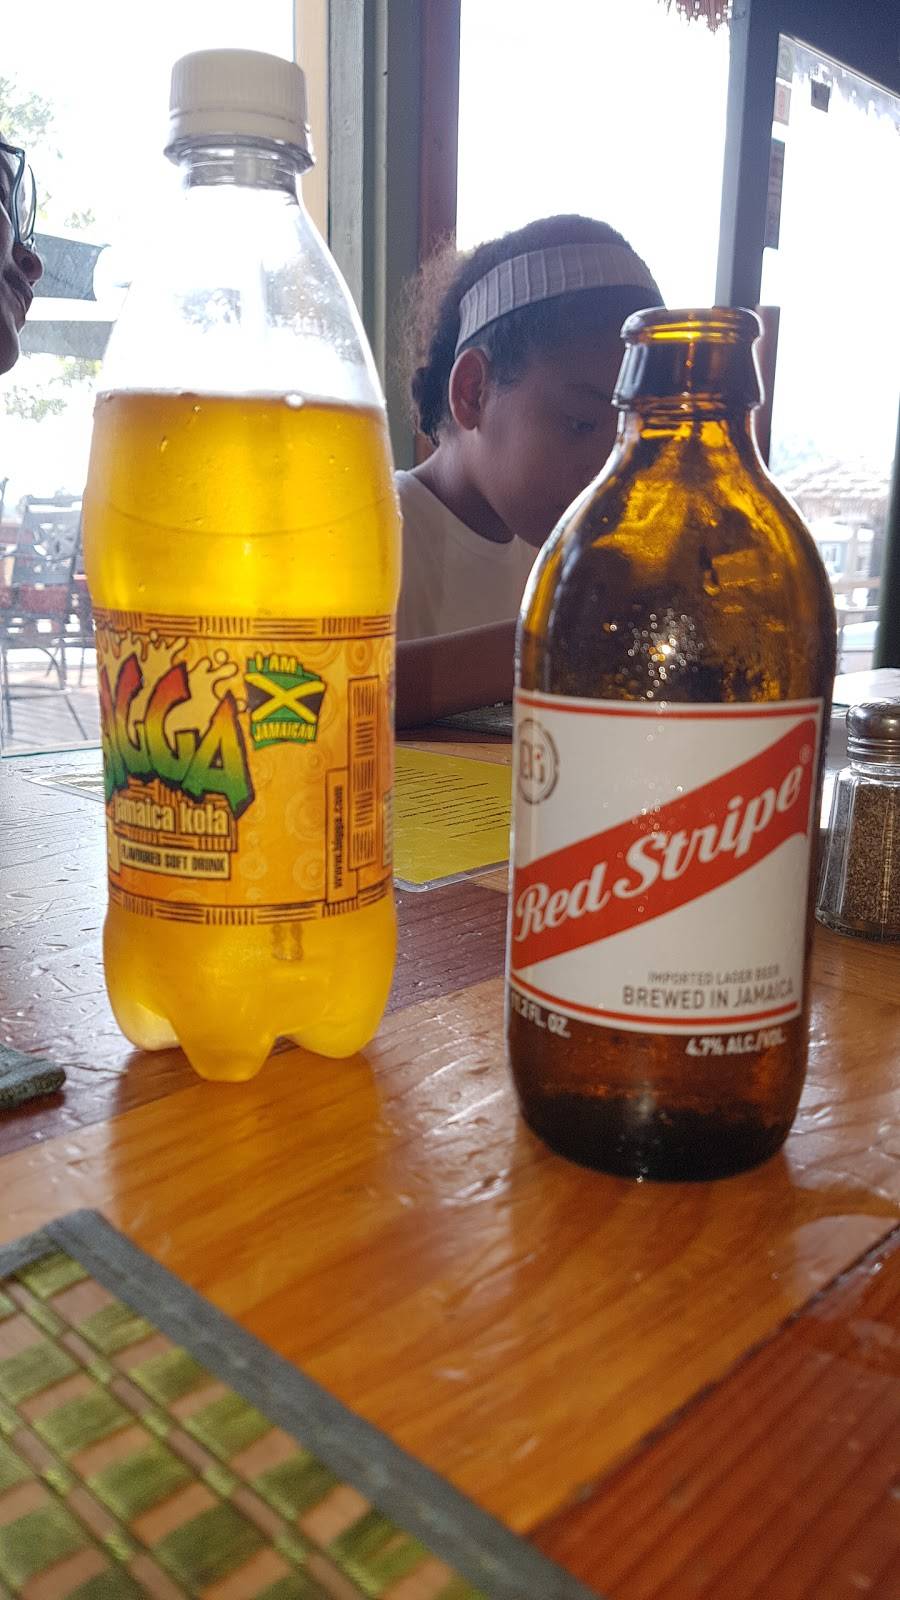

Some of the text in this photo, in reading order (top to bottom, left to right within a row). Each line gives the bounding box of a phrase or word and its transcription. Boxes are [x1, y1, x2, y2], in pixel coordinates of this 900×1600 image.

[255, 652, 297, 673] I AM
[255, 721, 316, 742] JAMAICAN
[180, 800, 229, 836] kola
[165, 853, 188, 871] SOFT
[191, 856, 226, 873] DRINK
[514, 861, 611, 942] Red
[612, 764, 804, 899] Stripe
[648, 963, 780, 987] IMPORTED LAGER BEER
[623, 976, 794, 1010] BREWED IN JAMAICA
